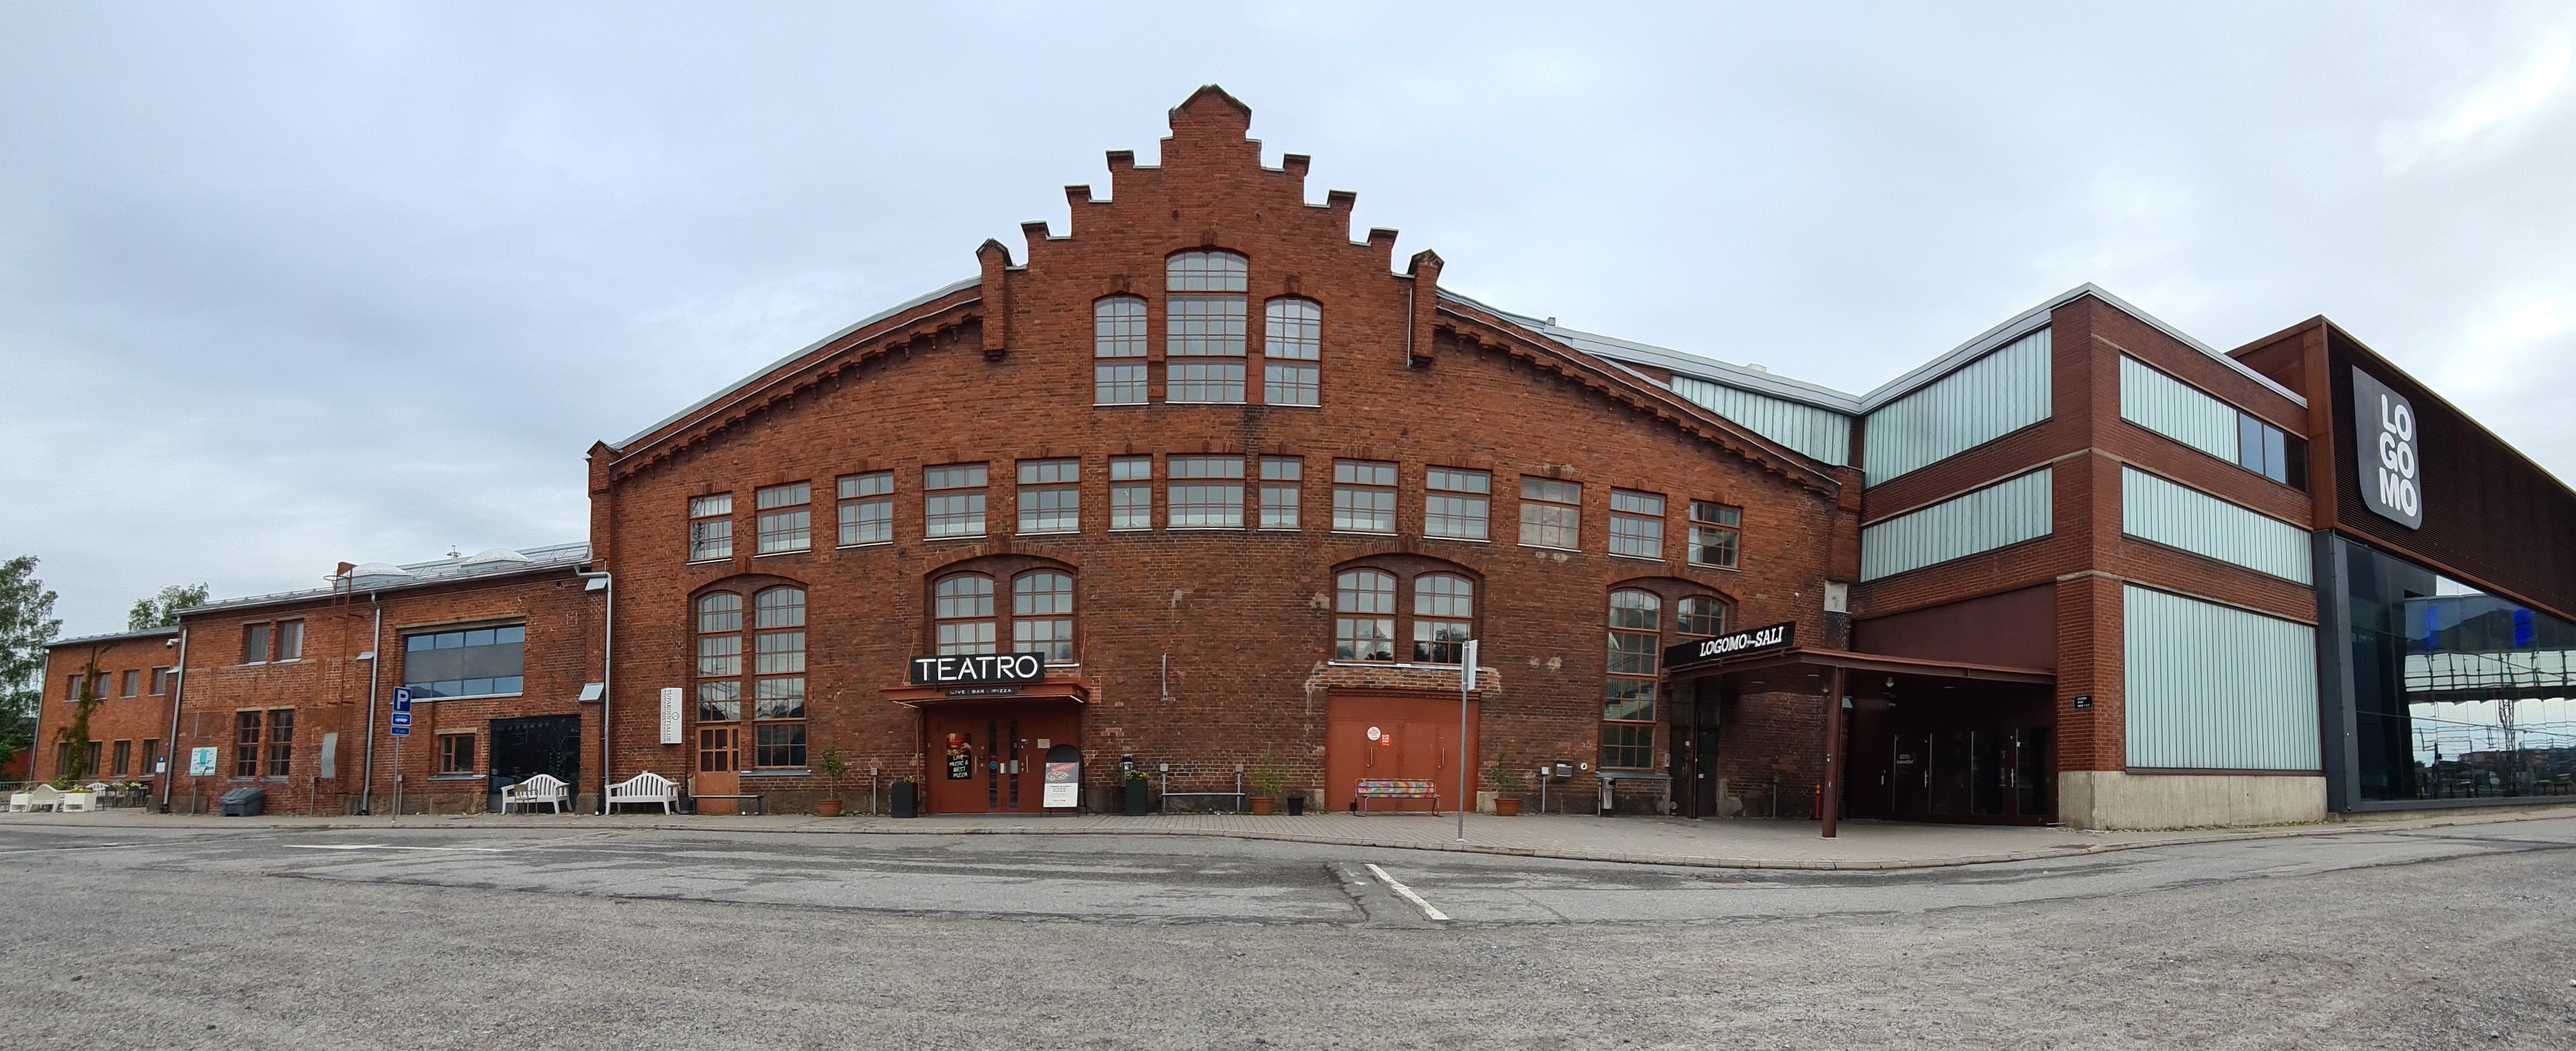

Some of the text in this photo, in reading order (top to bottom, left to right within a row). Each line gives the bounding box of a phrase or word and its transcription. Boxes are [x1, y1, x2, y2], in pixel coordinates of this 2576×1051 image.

[2381, 394, 2412, 442] LO
[2379, 432, 2415, 479] GO
[2379, 466, 2418, 517] MO
[915, 656, 1038, 681] TEATRO
[397, 689, 409, 710] P
